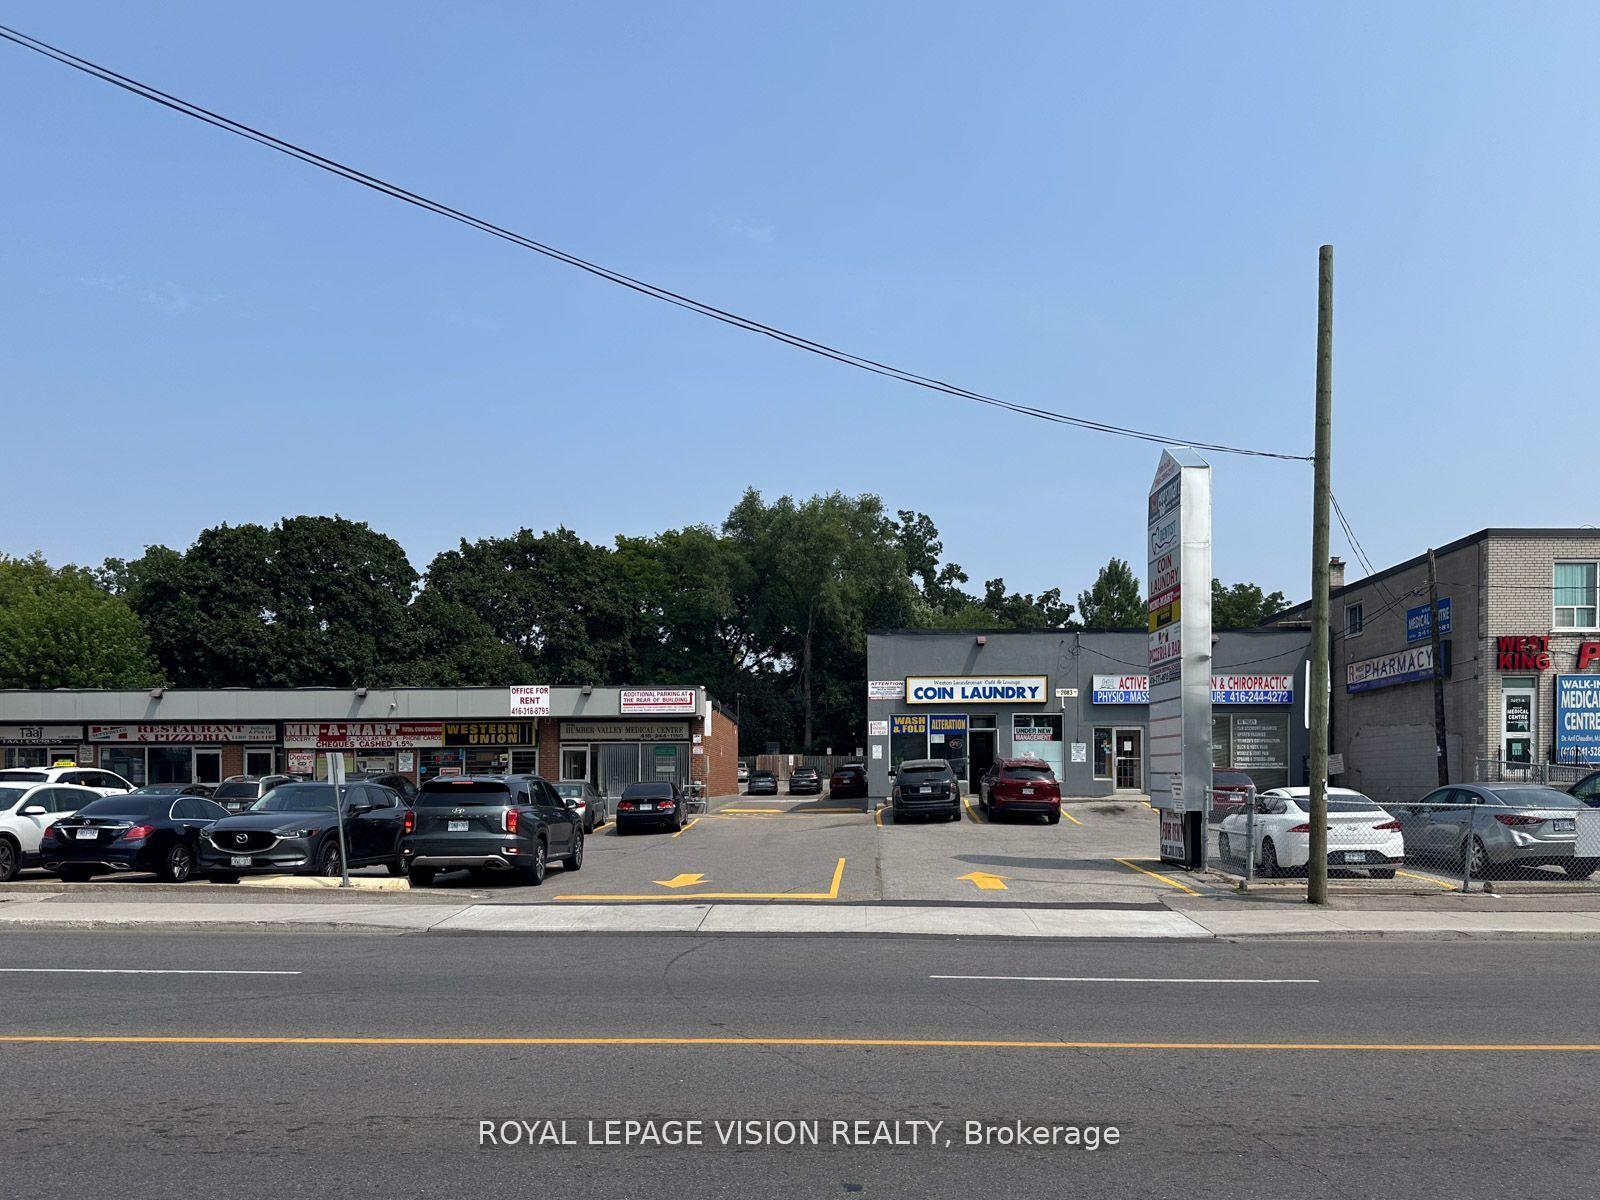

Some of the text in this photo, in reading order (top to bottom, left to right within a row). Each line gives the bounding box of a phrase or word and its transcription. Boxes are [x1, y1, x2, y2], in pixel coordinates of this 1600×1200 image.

[1157, 553, 1172, 573] COIN
[1150, 568, 1179, 594] LAUNDRY
[1408, 613, 1430, 630] MEDICAL
[1497, 636, 1551, 652] WEST
[1364, 649, 1434, 678] PHARMACY
[1497, 652, 1550, 670] KING
[1119, 676, 1147, 690] ACTIVE
[1220, 677, 1226, 690] &
[1228, 676, 1288, 690] CHIROPRACTIC
[914, 686, 954, 700] COIN
[961, 686, 1040, 699] LAUNDRY
[1097, 691, 1125, 702] PHYSIO
[1229, 691, 1289, 702] 416-244-4272
[1561, 690, 1600, 708] MEDICA
[520, 696, 540, 704] RENT
[511, 707, 549, 715] 416-318-8795
[894, 716, 926, 725] WASH
[931, 719, 966, 730] ALTERATION
[1564, 712, 1600, 730] CENTRE
[19, 727, 43, 739] Taaj
[137, 725, 244, 733] RESTAURANT
[285, 724, 400, 736] MIN-A-MART
[447, 724, 518, 734] WESTERN
[565, 726, 595, 734] HUMBER
[597, 726, 622, 734] VALLEY
[902, 725, 926, 733] FOLD
[137, 734, 149, 742] &
[154, 733, 230, 741] PIZZERIA
[468, 734, 518, 744] UNION
